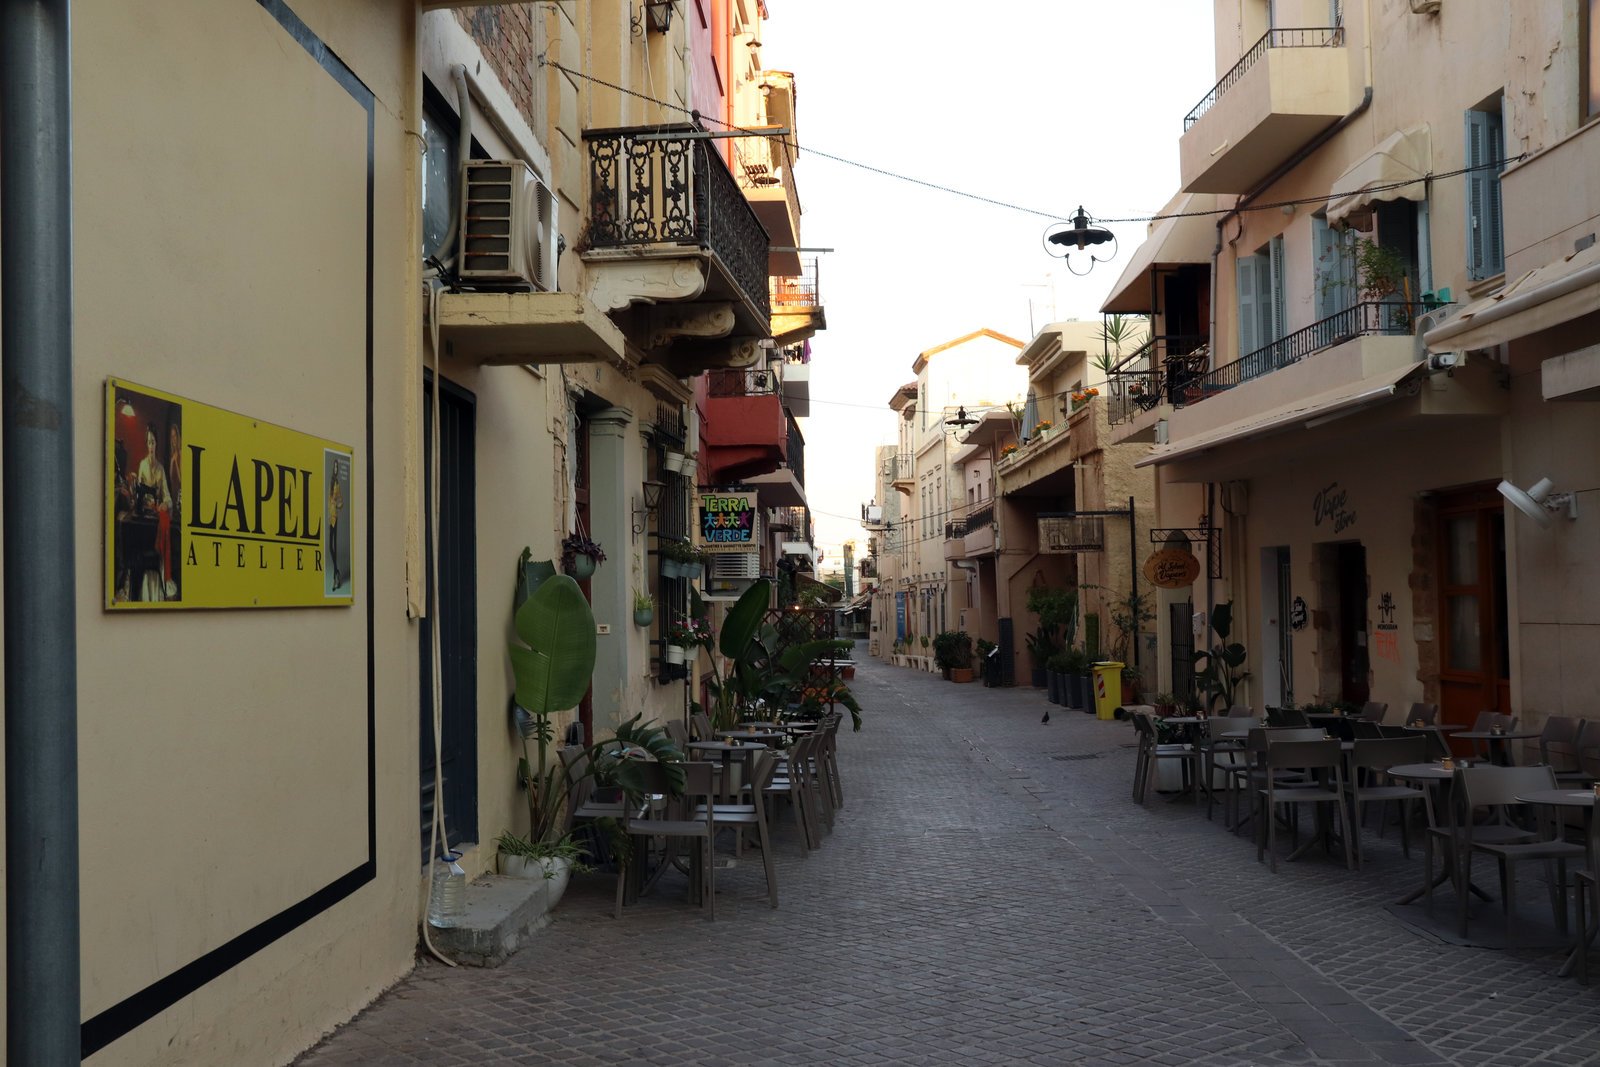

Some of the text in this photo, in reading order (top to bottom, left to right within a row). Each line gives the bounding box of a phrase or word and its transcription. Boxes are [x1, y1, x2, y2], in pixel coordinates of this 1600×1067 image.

[187, 444, 321, 540] LAPEL
[701, 494, 750, 512] TERRA
[1313, 481, 1347, 526] Vape
[704, 529, 751, 542] VERDE
[186, 540, 322, 571] ATELIER
